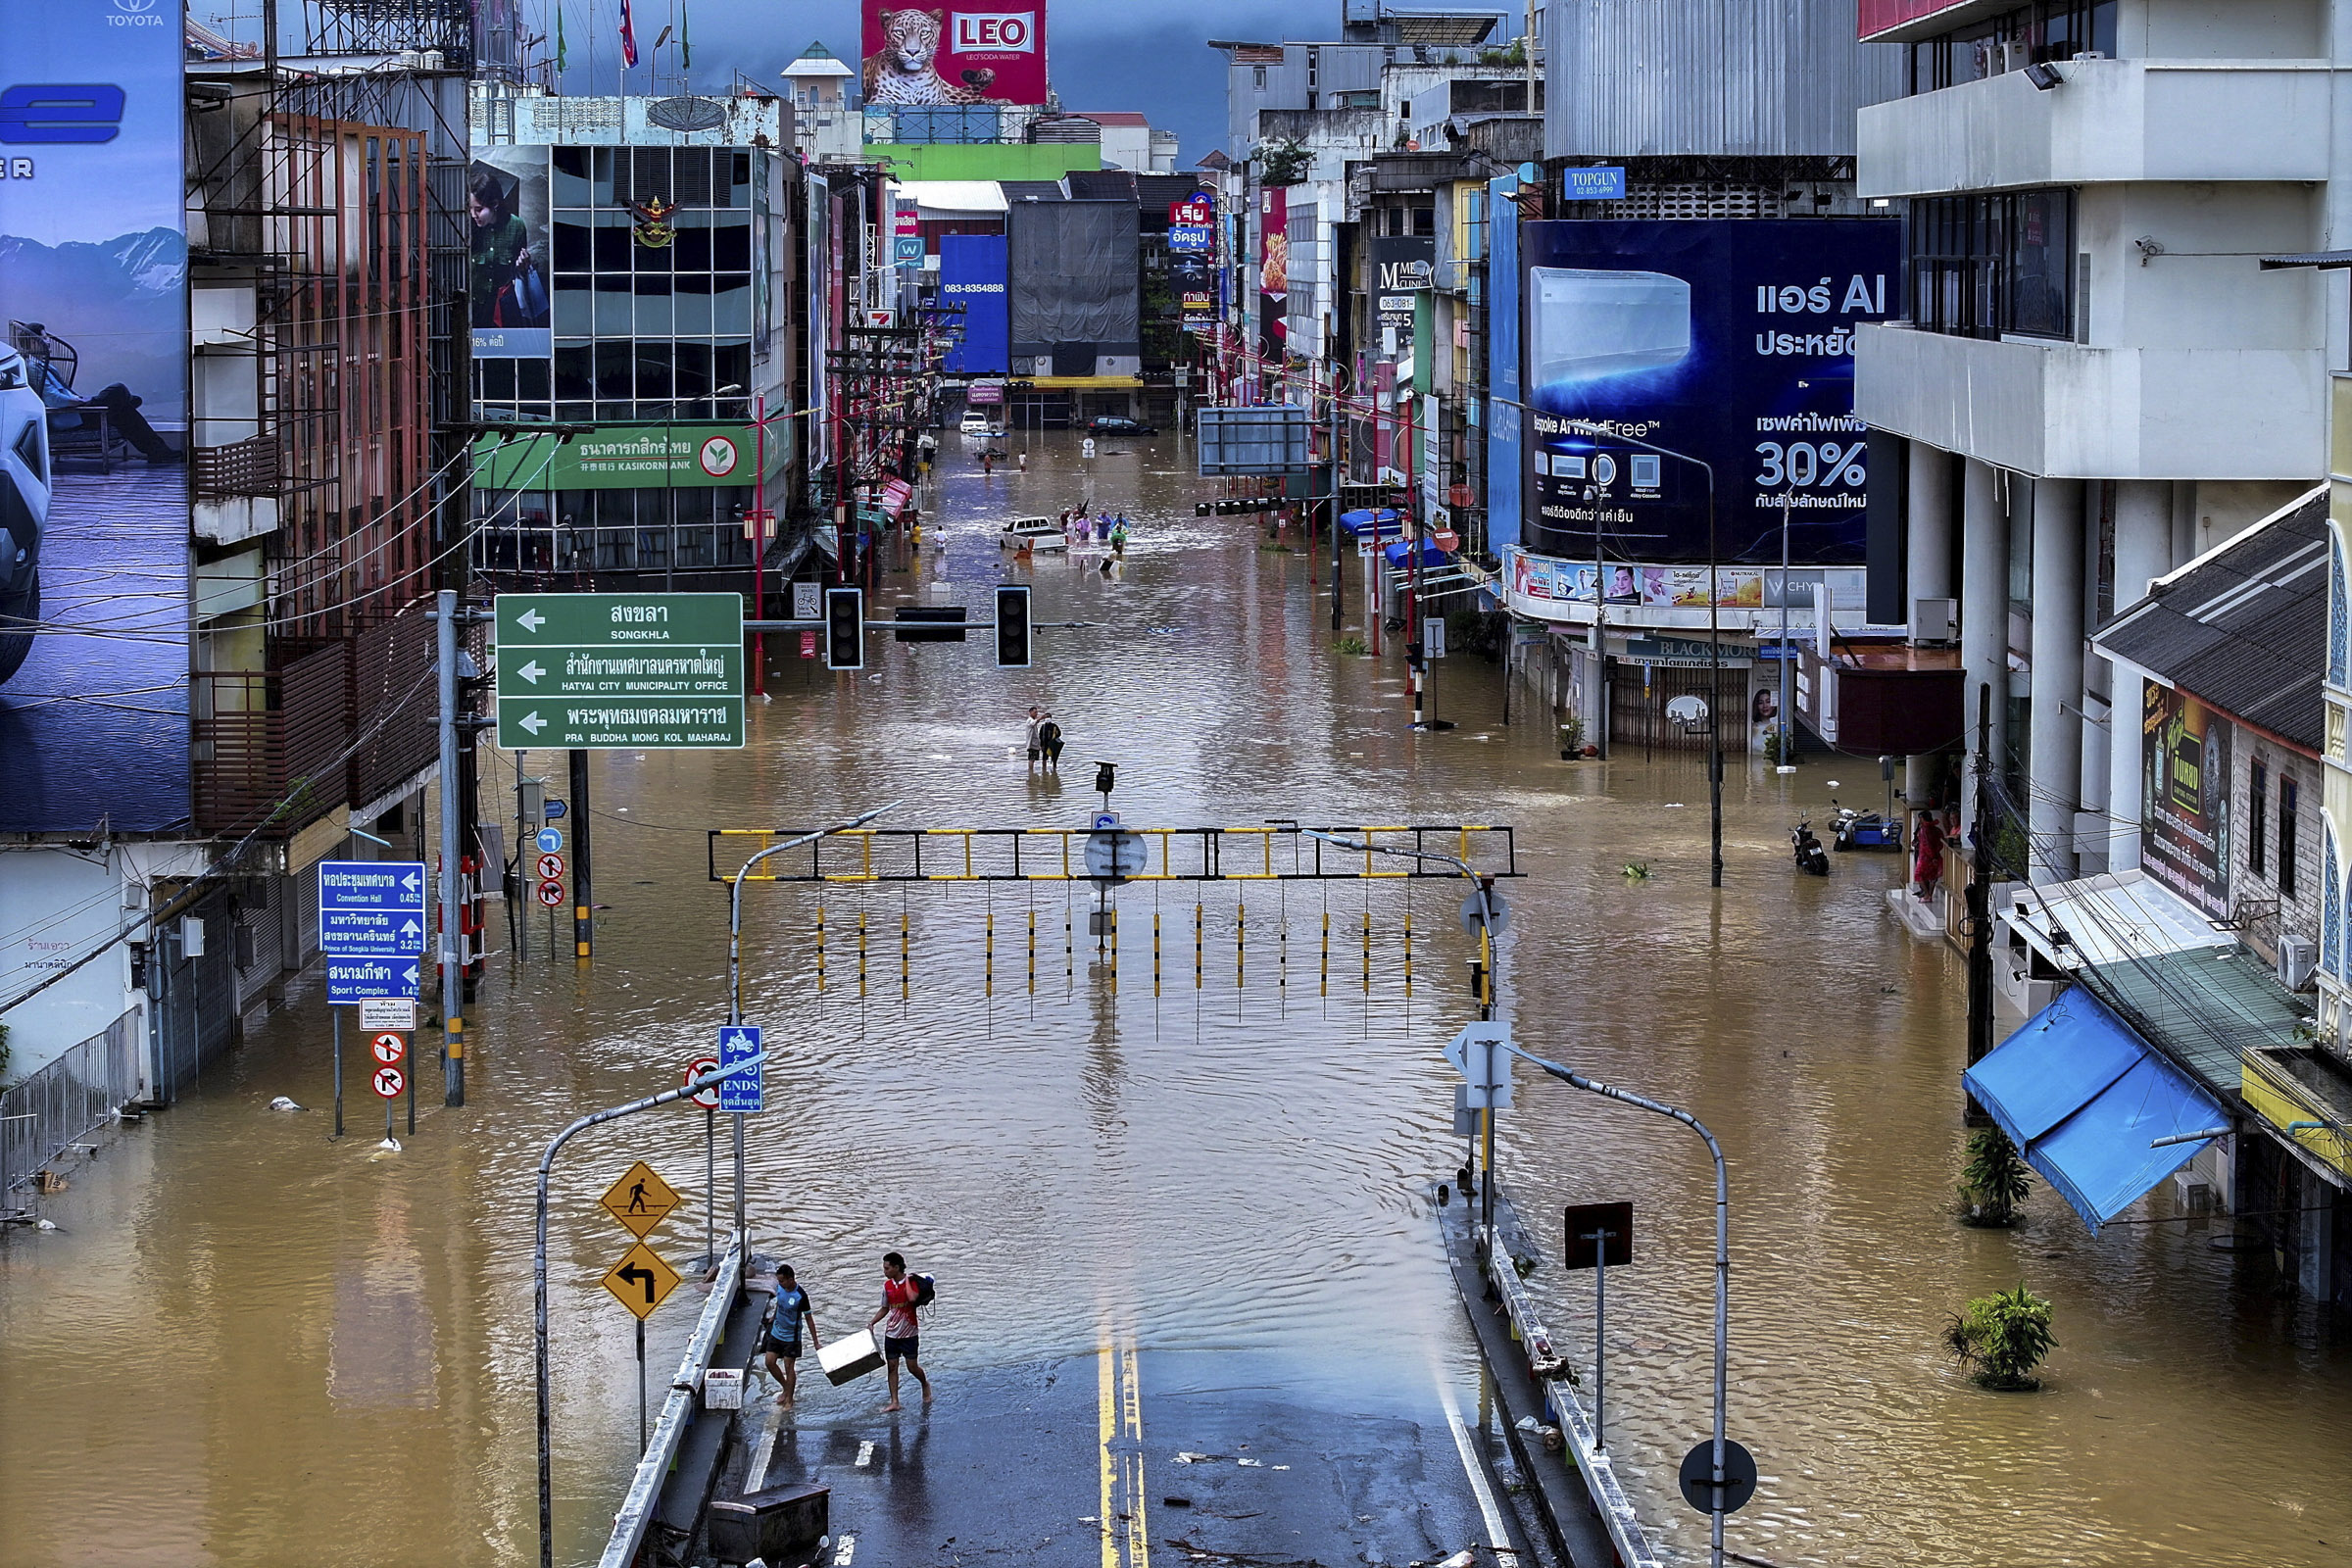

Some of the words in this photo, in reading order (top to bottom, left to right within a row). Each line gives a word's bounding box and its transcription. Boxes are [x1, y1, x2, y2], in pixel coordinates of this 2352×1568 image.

[106, 15, 164, 26] TOYOTA
[959, 18, 1028, 48] LEO
[0, 159, 32, 177] R
[1572, 172, 1617, 186] TOPGUN
[1172, 229, 1206, 247] อัดรูป
[944, 284, 1004, 294] 083-8354888
[1757, 276, 1832, 314] แอร์
[1839, 274, 1886, 314] AI
[1755, 441, 1866, 486] 30%
[1767, 578, 1814, 597] VCHY
[611, 605, 668, 622] สงขลา
[565, 649, 724, 678] สำนักงานเทศบาลนครหาดใหญ่
[566, 707, 727, 730] พระพุทธมงคลมหาราช
[323, 872, 395, 893] หอประชุมเทศบาล
[336, 894, 368, 903] Convention
[400, 894, 415, 903] 0.45
[330, 913, 389, 926] มหาวิทยาลัย
[323, 930, 396, 942] สงขลานครินทร์
[400, 940, 413, 950] 3.2
[328, 961, 391, 980] สนามกีฬา
[330, 986, 353, 996] Sport
[355, 986, 389, 996] Complex
[401, 986, 413, 996] 1.4
[723, 1080, 759, 1092] ENDS
[722, 1093, 760, 1109] จุดสิ้นสุด
